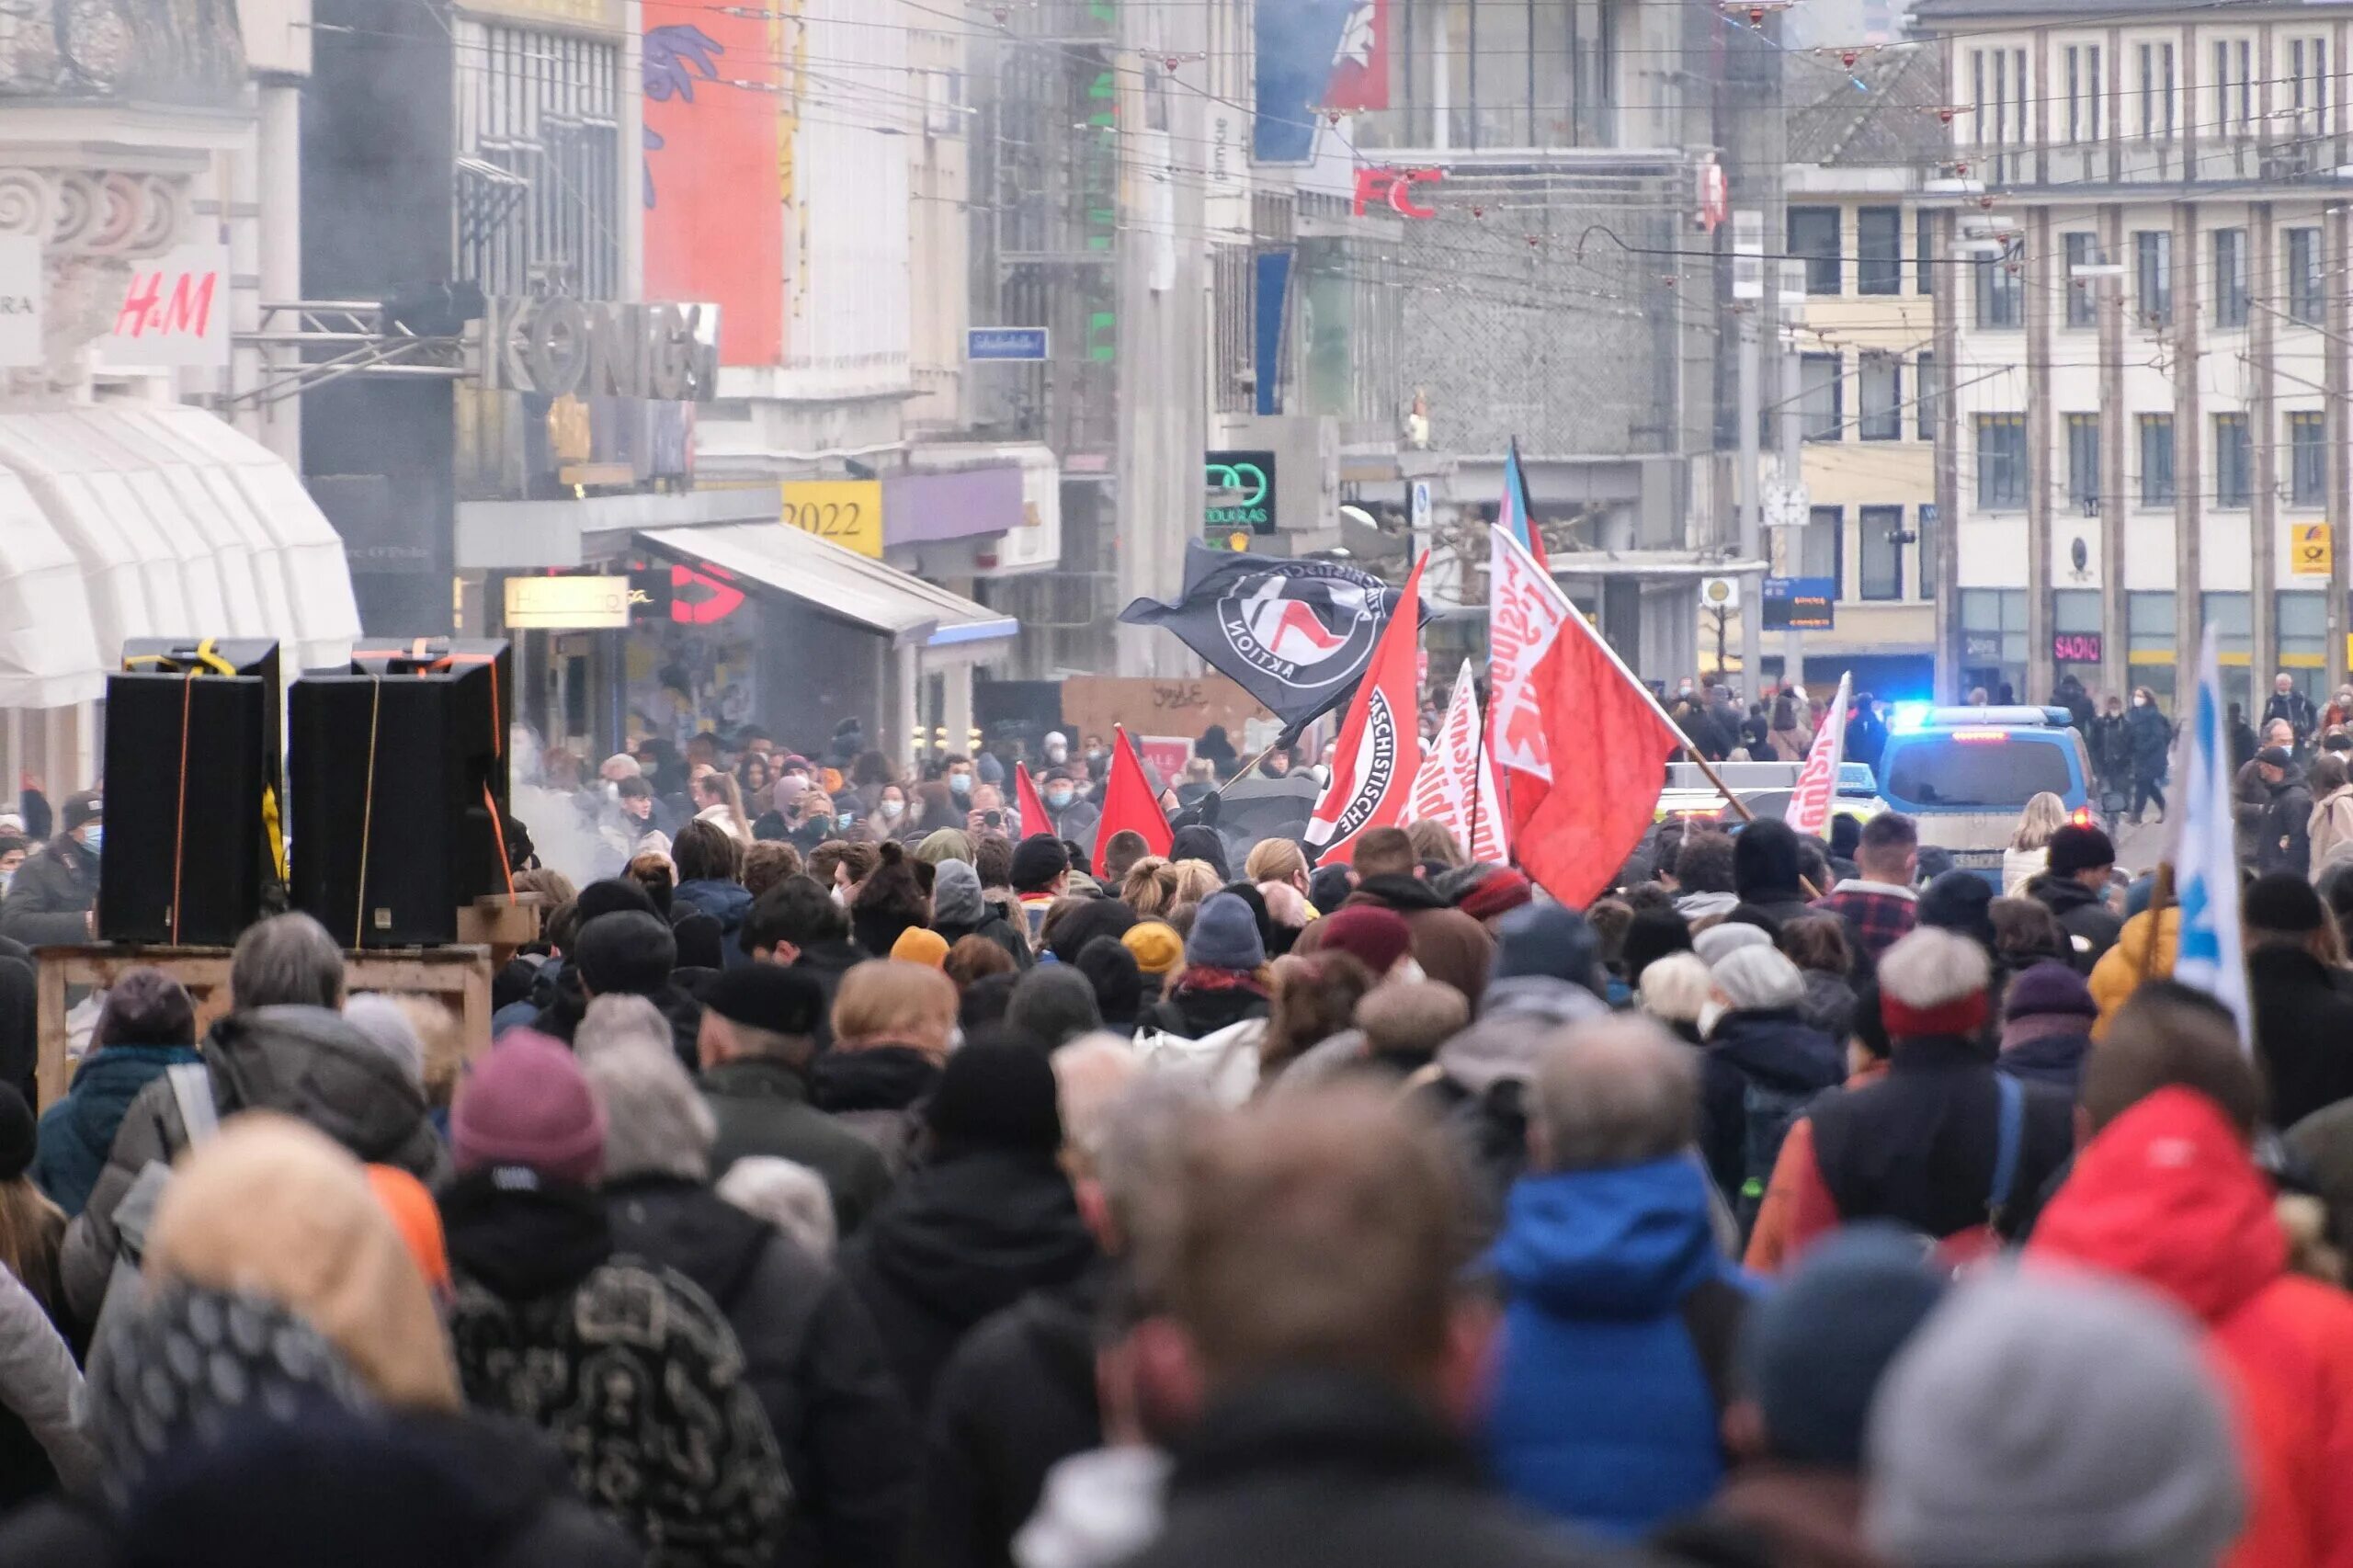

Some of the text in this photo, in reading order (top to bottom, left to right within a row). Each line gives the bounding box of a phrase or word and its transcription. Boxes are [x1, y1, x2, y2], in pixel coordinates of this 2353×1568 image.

[113, 271, 216, 338] H&M
[782, 501, 861, 536] 2022
[1339, 694, 1392, 833] ASCHISTISCHE
